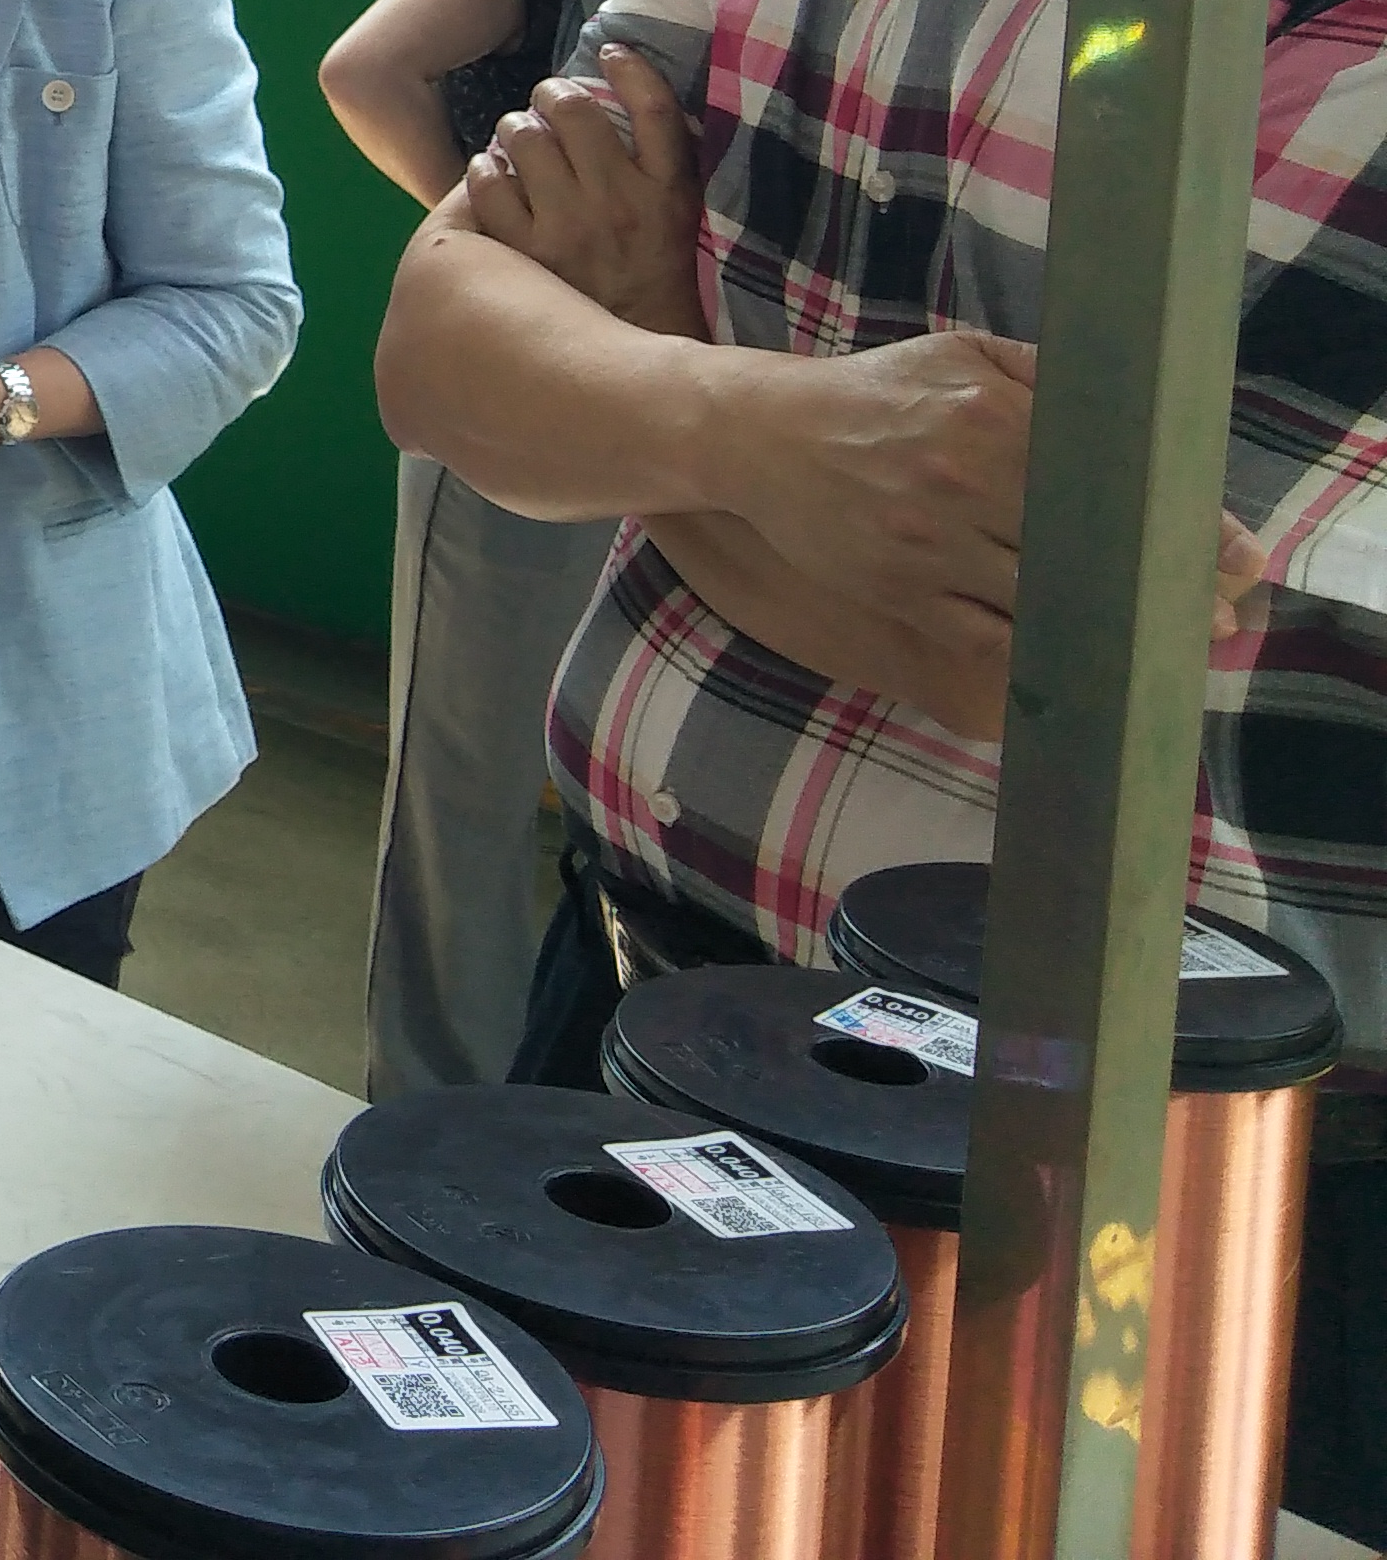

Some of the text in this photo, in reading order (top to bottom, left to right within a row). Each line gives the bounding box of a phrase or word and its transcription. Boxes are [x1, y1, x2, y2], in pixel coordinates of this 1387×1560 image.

[866, 995, 930, 1020] 0.040
[704, 1144, 761, 1179] 0.040
[417, 1312, 470, 1356] 0.040
